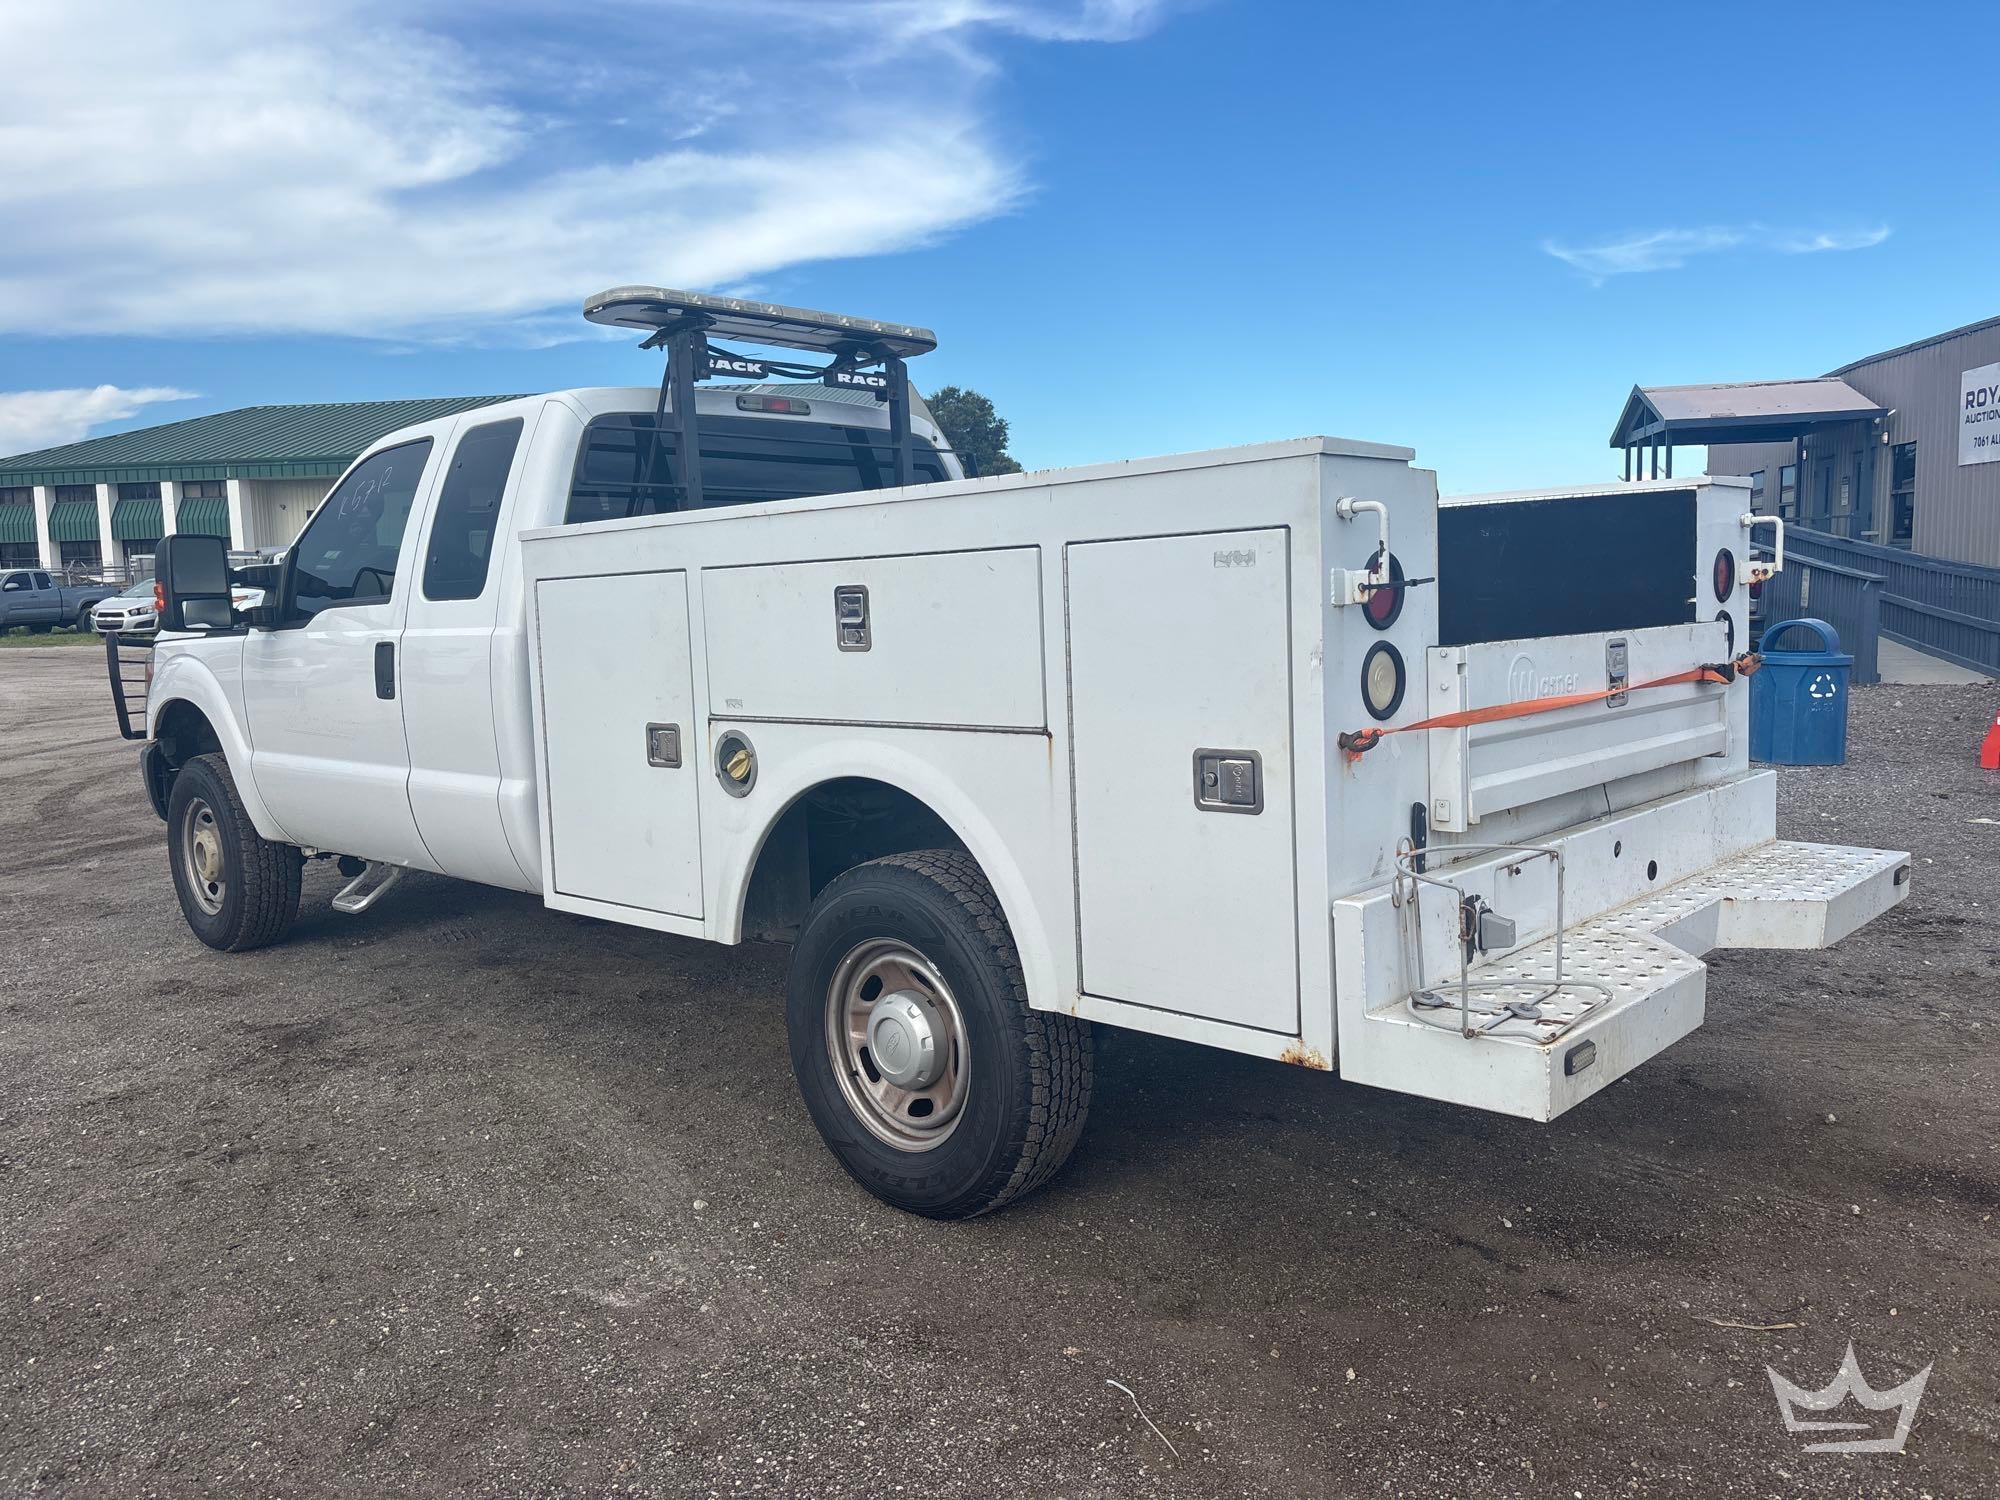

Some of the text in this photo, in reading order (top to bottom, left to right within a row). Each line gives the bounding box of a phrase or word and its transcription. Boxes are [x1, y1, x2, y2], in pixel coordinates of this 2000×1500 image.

[1965, 385, 2000, 410] ROY
[1974, 434, 2000, 449] 7061 AL
